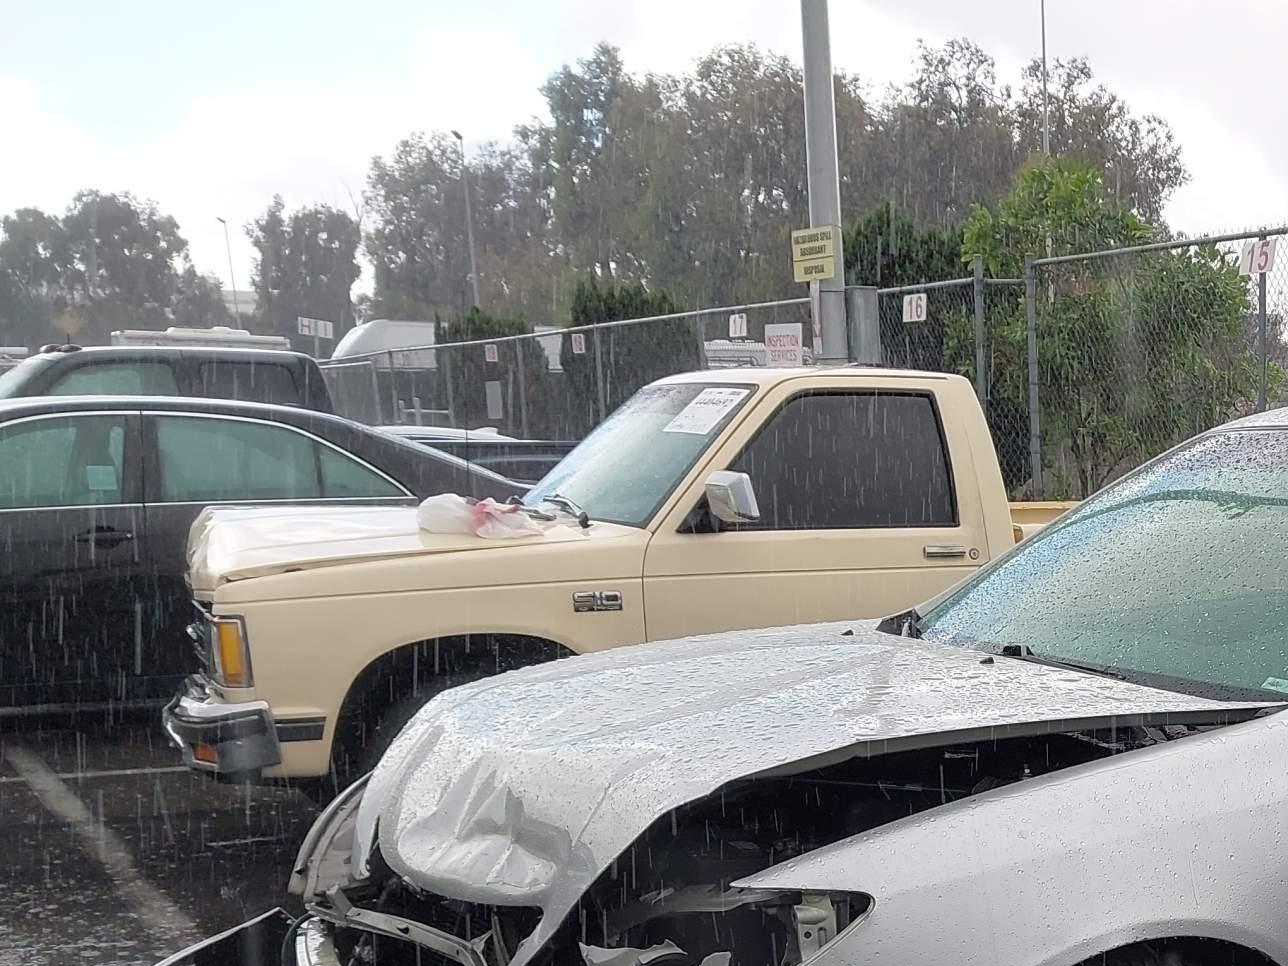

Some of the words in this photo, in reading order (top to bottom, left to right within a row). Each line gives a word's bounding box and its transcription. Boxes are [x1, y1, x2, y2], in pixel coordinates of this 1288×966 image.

[1247, 241, 1270, 273] 15
[908, 295, 923, 320] 16
[733, 313, 745, 336] 17
[767, 334, 799, 348] INSPECTION
[769, 349, 798, 361] SERVICES
